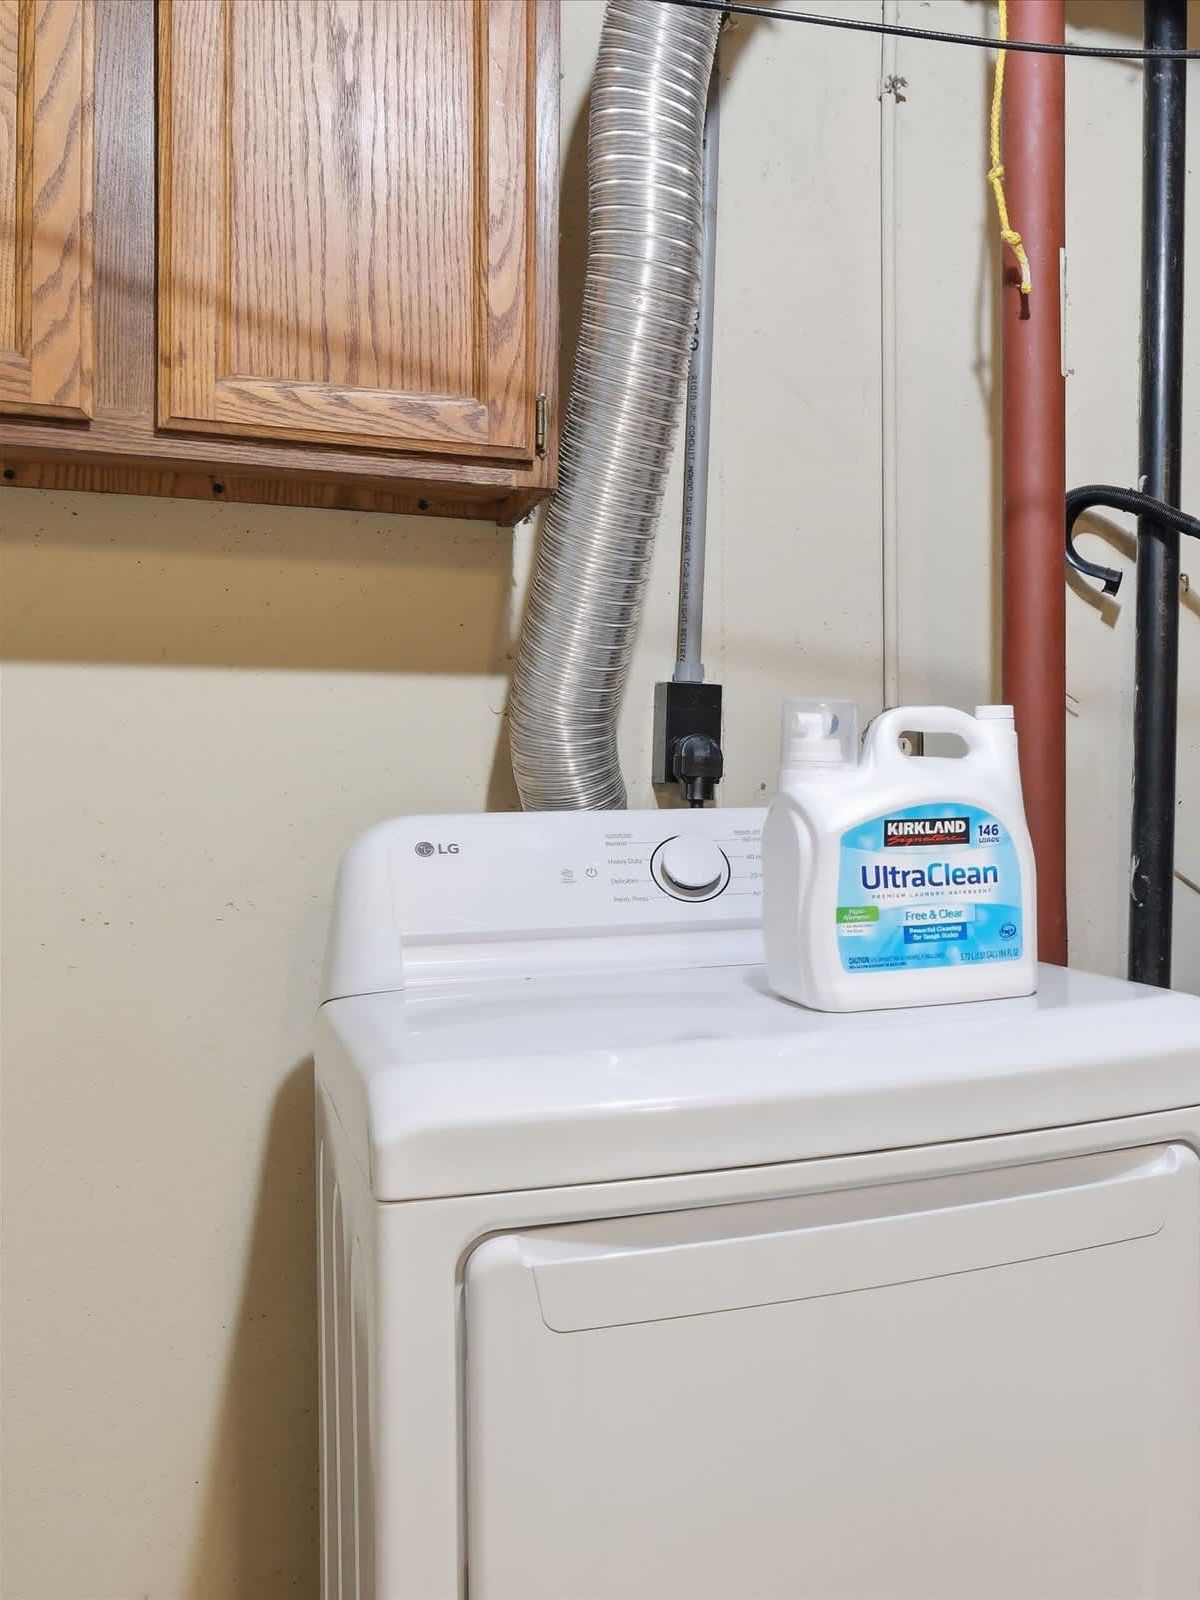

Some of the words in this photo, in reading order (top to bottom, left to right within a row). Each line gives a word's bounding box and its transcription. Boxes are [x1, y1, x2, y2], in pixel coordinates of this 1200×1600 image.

[887, 820, 967, 836] KIRKLAND
[978, 824, 999, 837] 146
[887, 834, 967, 847] Signature
[438, 843, 460, 855] LG
[861, 863, 998, 890] UltraClean
[872, 892, 906, 900] PREMIUM
[905, 911, 928, 921] Free
[928, 910, 937, 920] &
[938, 908, 963, 919] Clear
